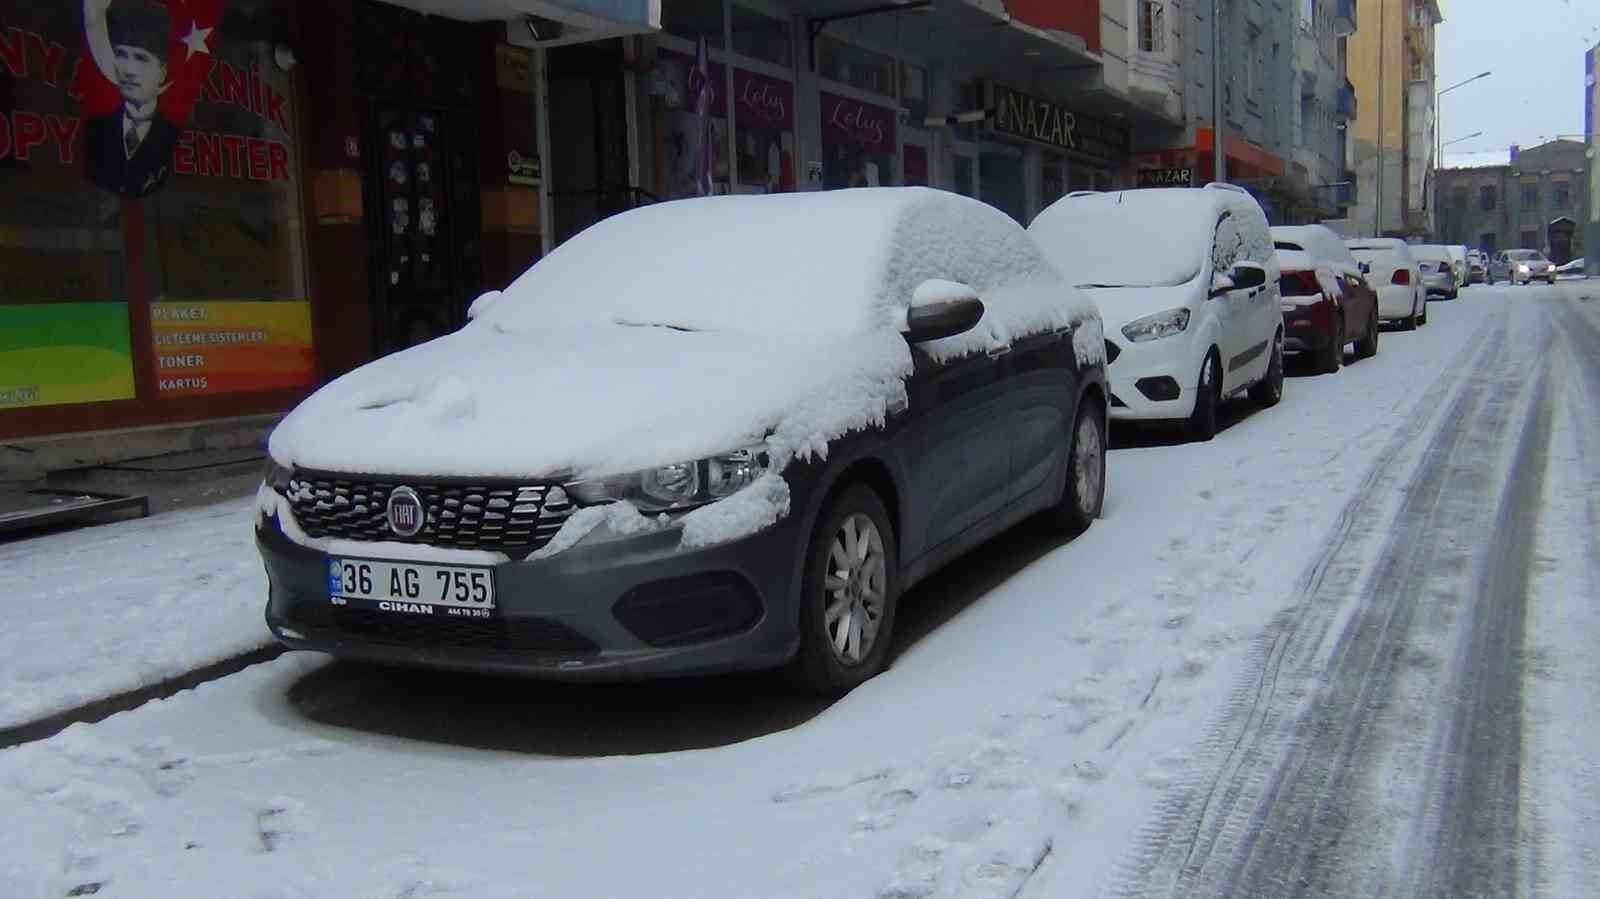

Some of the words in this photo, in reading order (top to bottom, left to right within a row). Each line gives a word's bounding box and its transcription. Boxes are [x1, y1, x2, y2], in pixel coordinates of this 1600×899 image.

[832, 102, 885, 143] Lotus
[1009, 92, 1076, 147] NAZAR
[158, 354, 205, 369] TONER
[393, 503, 416, 524] FIAT
[343, 564, 372, 595] 36
[390, 567, 420, 598] AG
[437, 571, 487, 602] 755
